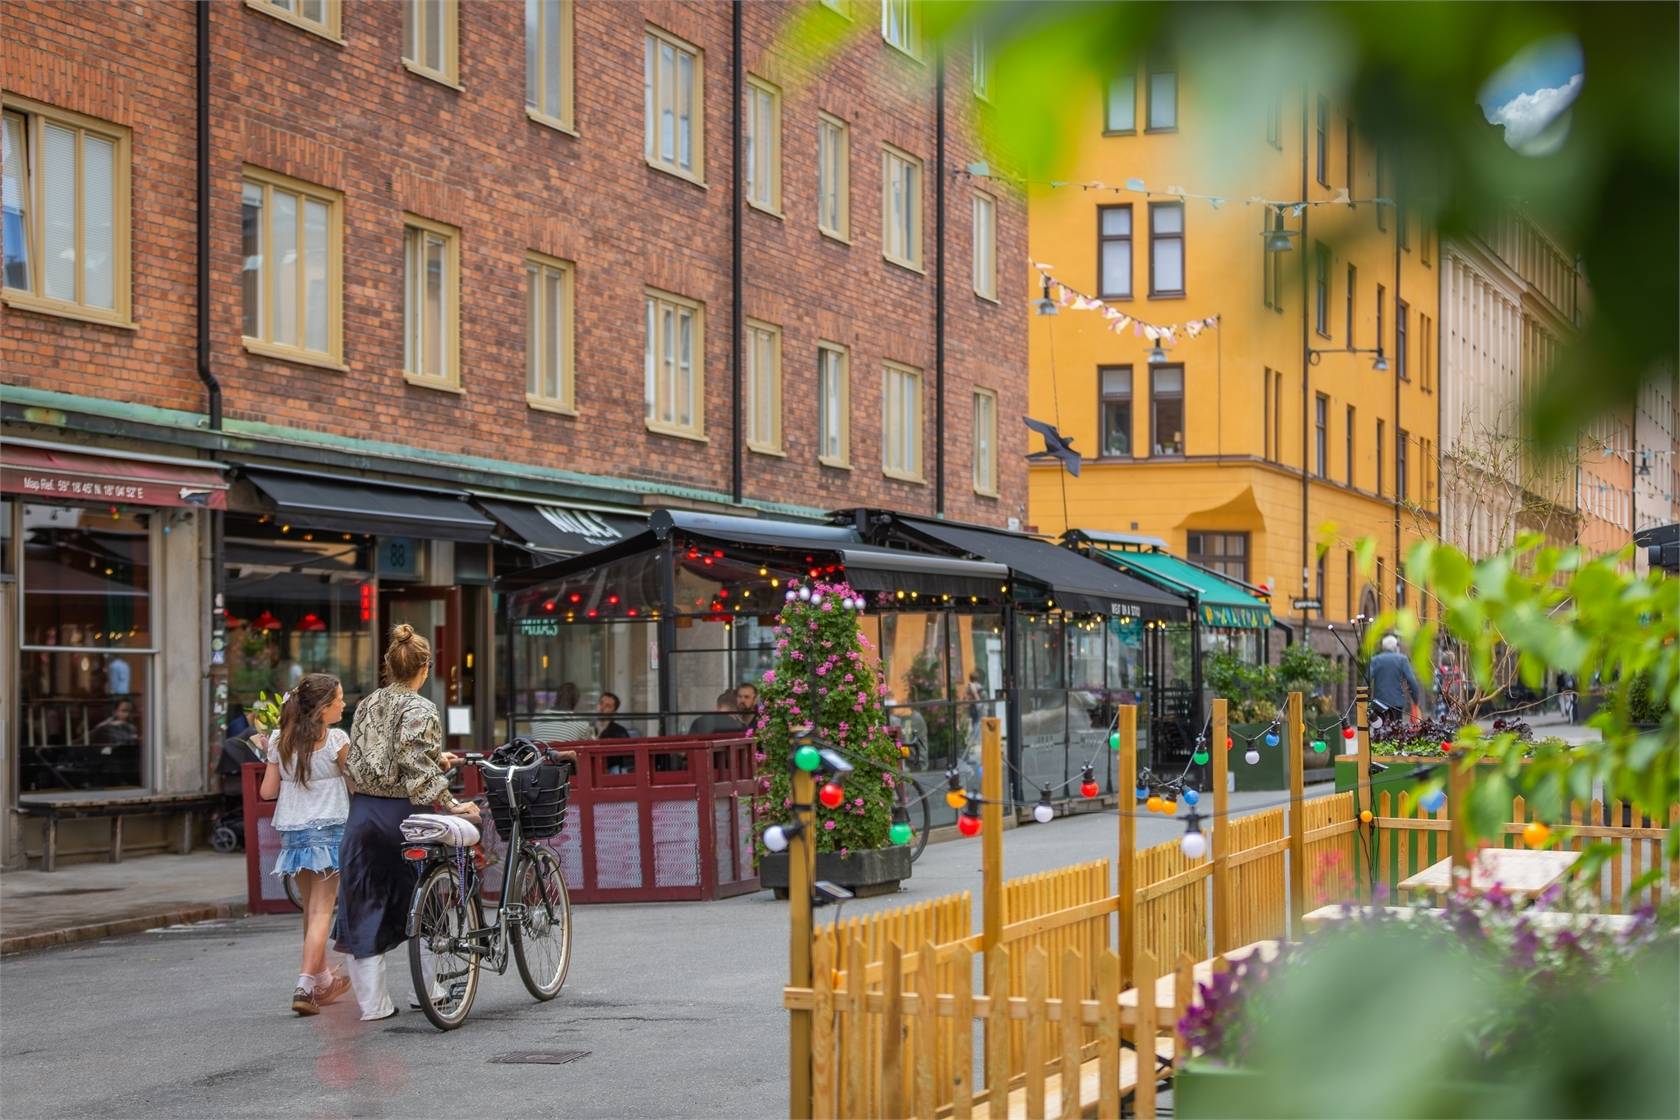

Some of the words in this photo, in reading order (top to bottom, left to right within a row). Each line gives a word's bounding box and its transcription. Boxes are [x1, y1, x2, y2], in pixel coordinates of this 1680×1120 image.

[24, 477, 40, 492] Map
[137, 487, 144, 499] E
[390, 543, 406, 568] 88
